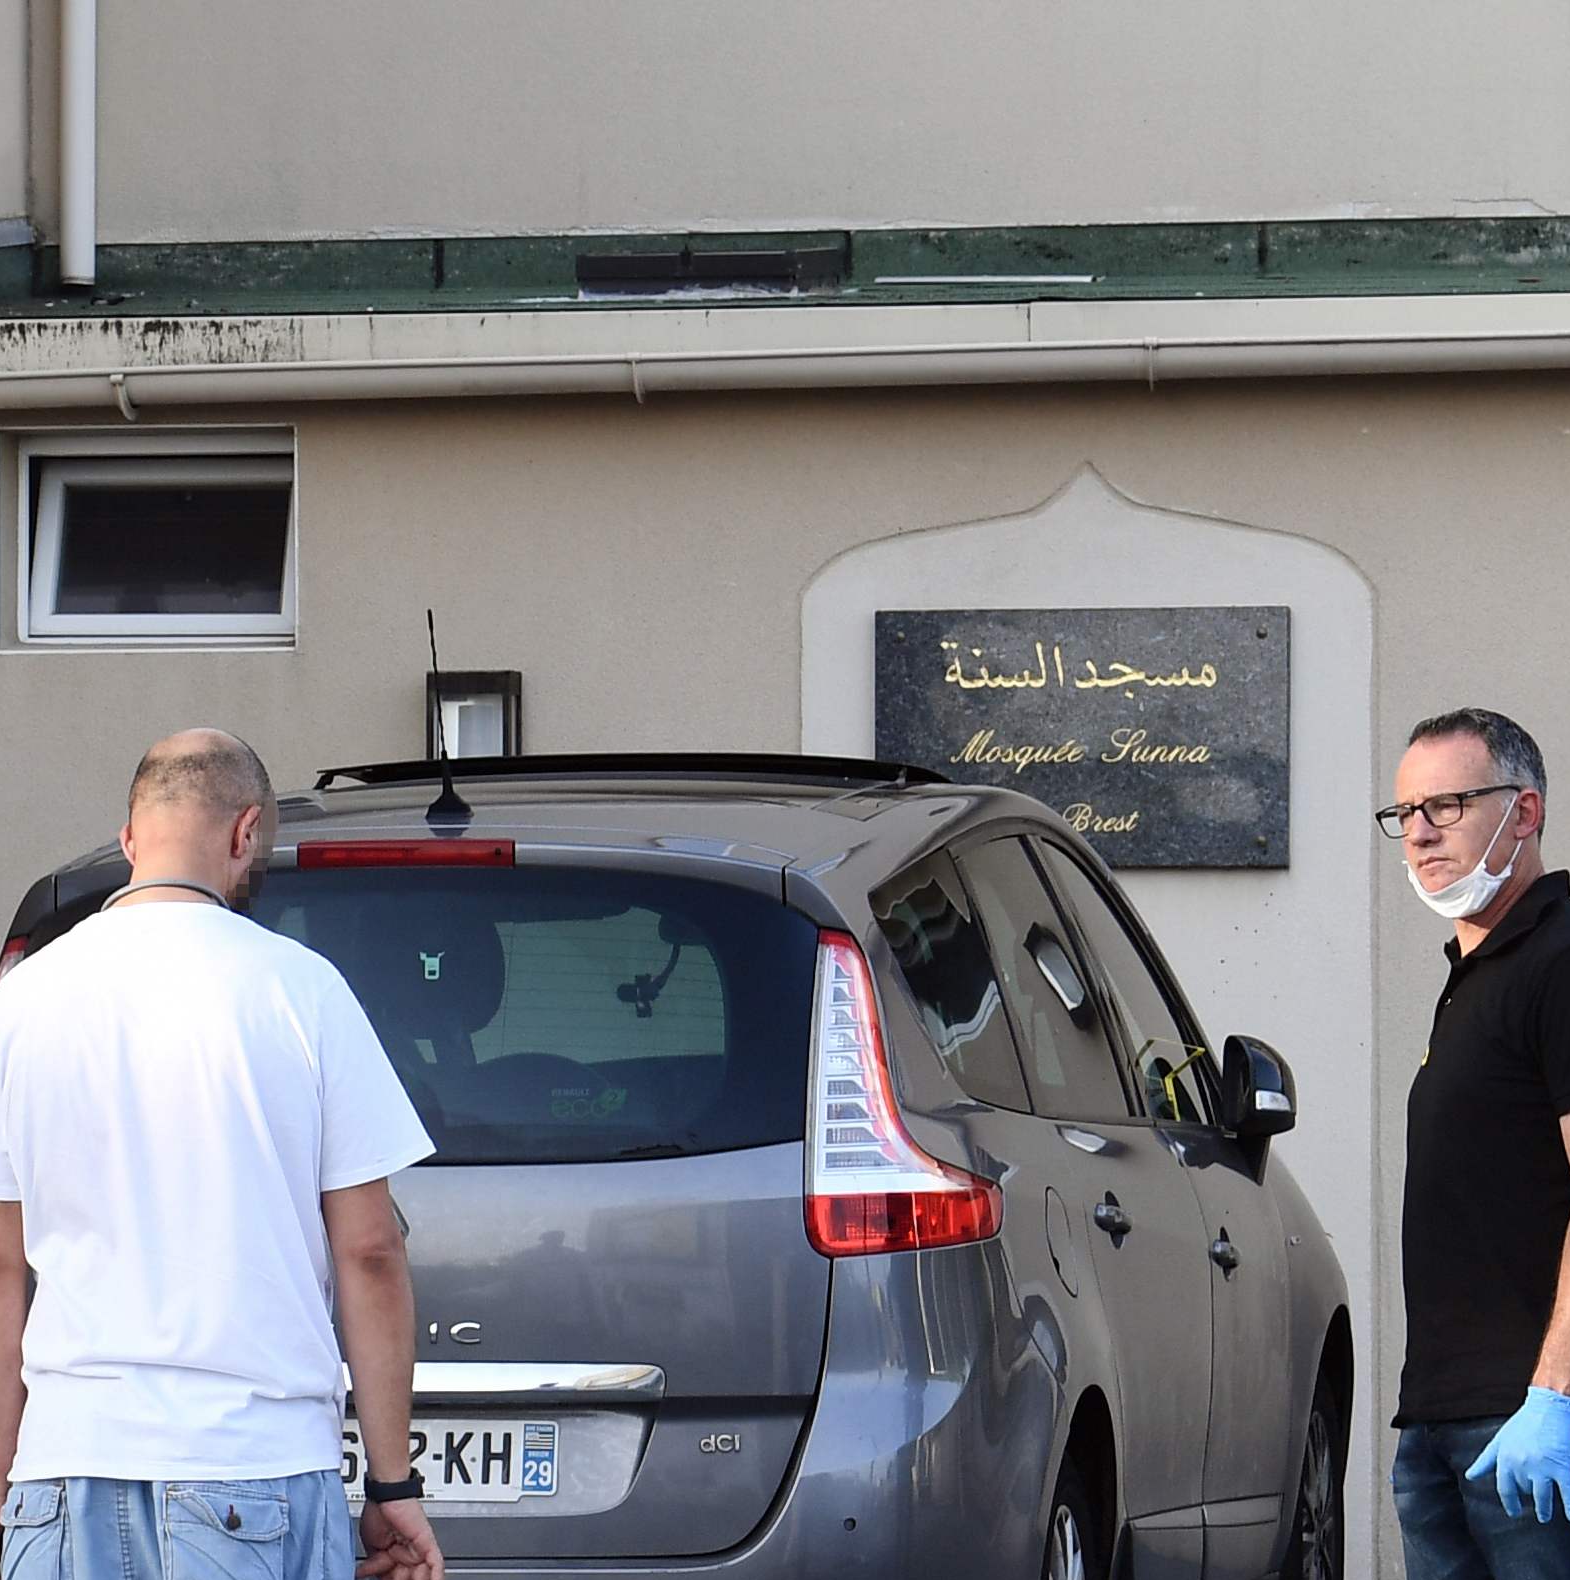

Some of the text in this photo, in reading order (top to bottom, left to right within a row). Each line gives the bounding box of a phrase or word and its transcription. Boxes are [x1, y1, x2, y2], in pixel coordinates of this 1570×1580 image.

[940, 641, 1218, 700] مسجد السنة
[950, 728, 1212, 774] Mosquée Sunna
[1062, 803, 1141, 832] Brest
[523, 1460, 553, 1487] 29
